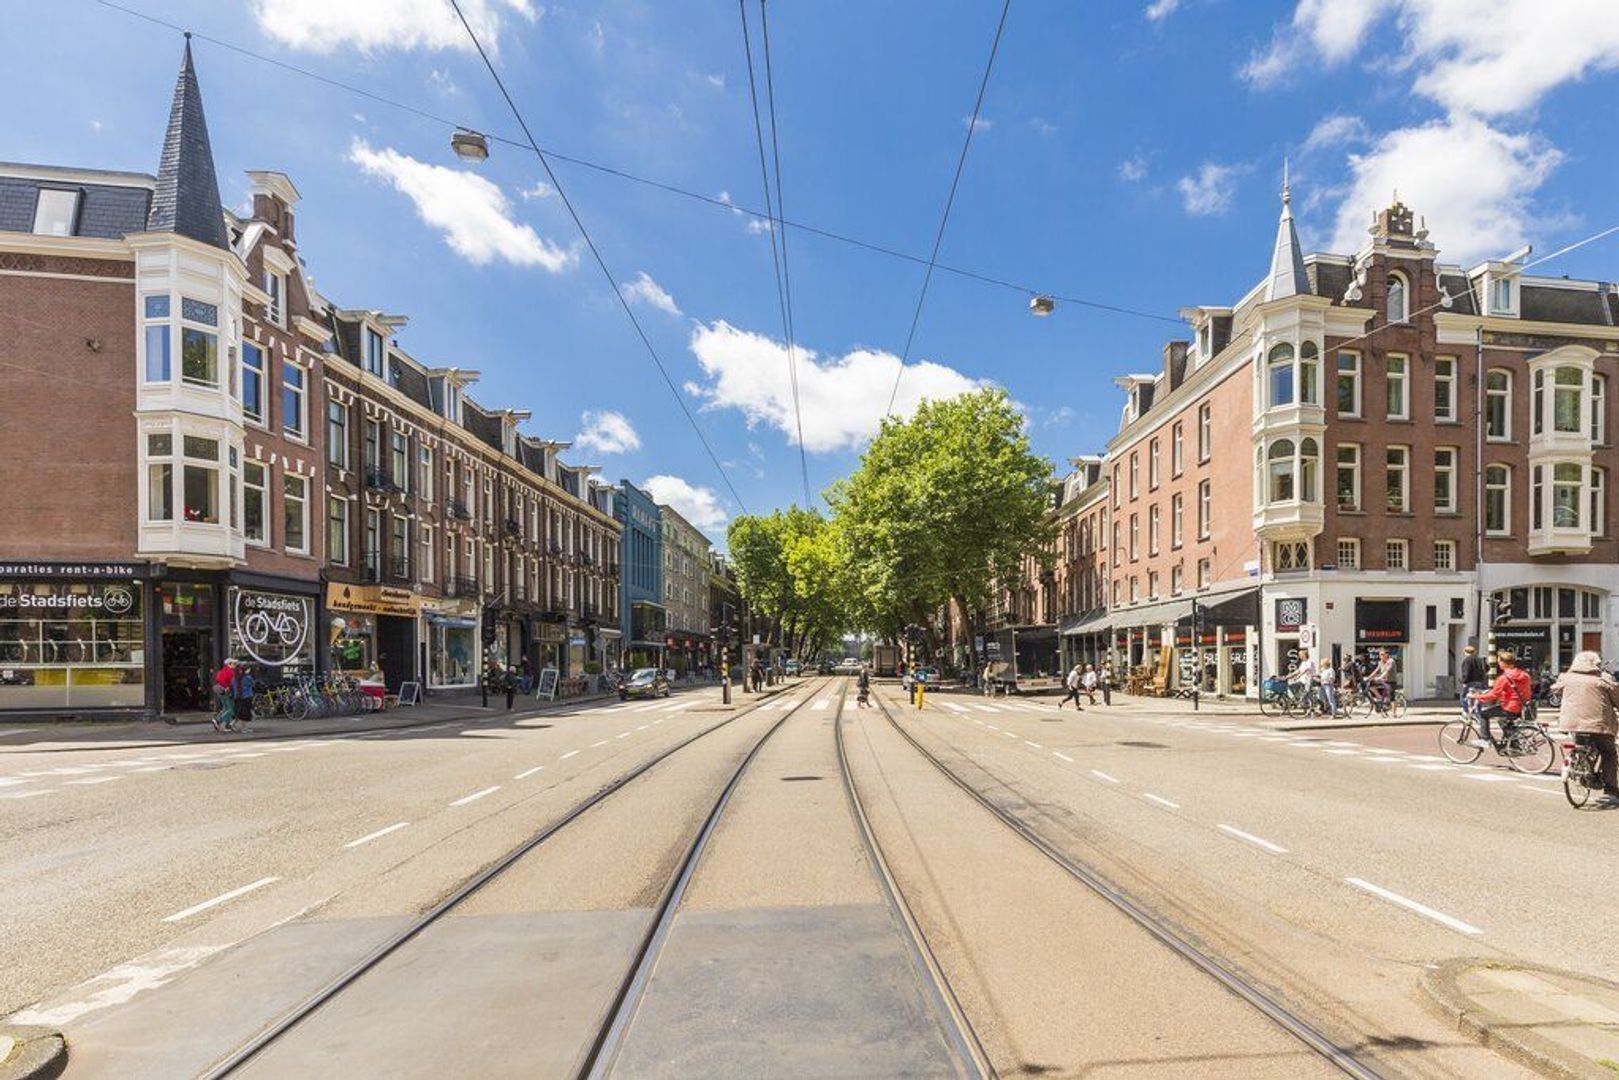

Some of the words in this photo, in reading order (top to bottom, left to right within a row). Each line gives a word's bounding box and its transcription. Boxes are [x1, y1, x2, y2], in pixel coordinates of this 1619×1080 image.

[60, 565, 133, 575] rent-a-bike
[20, 594, 103, 607] Stadsfiets
[244, 596, 256, 608] de
[257, 597, 300, 611] Stadsfiets
